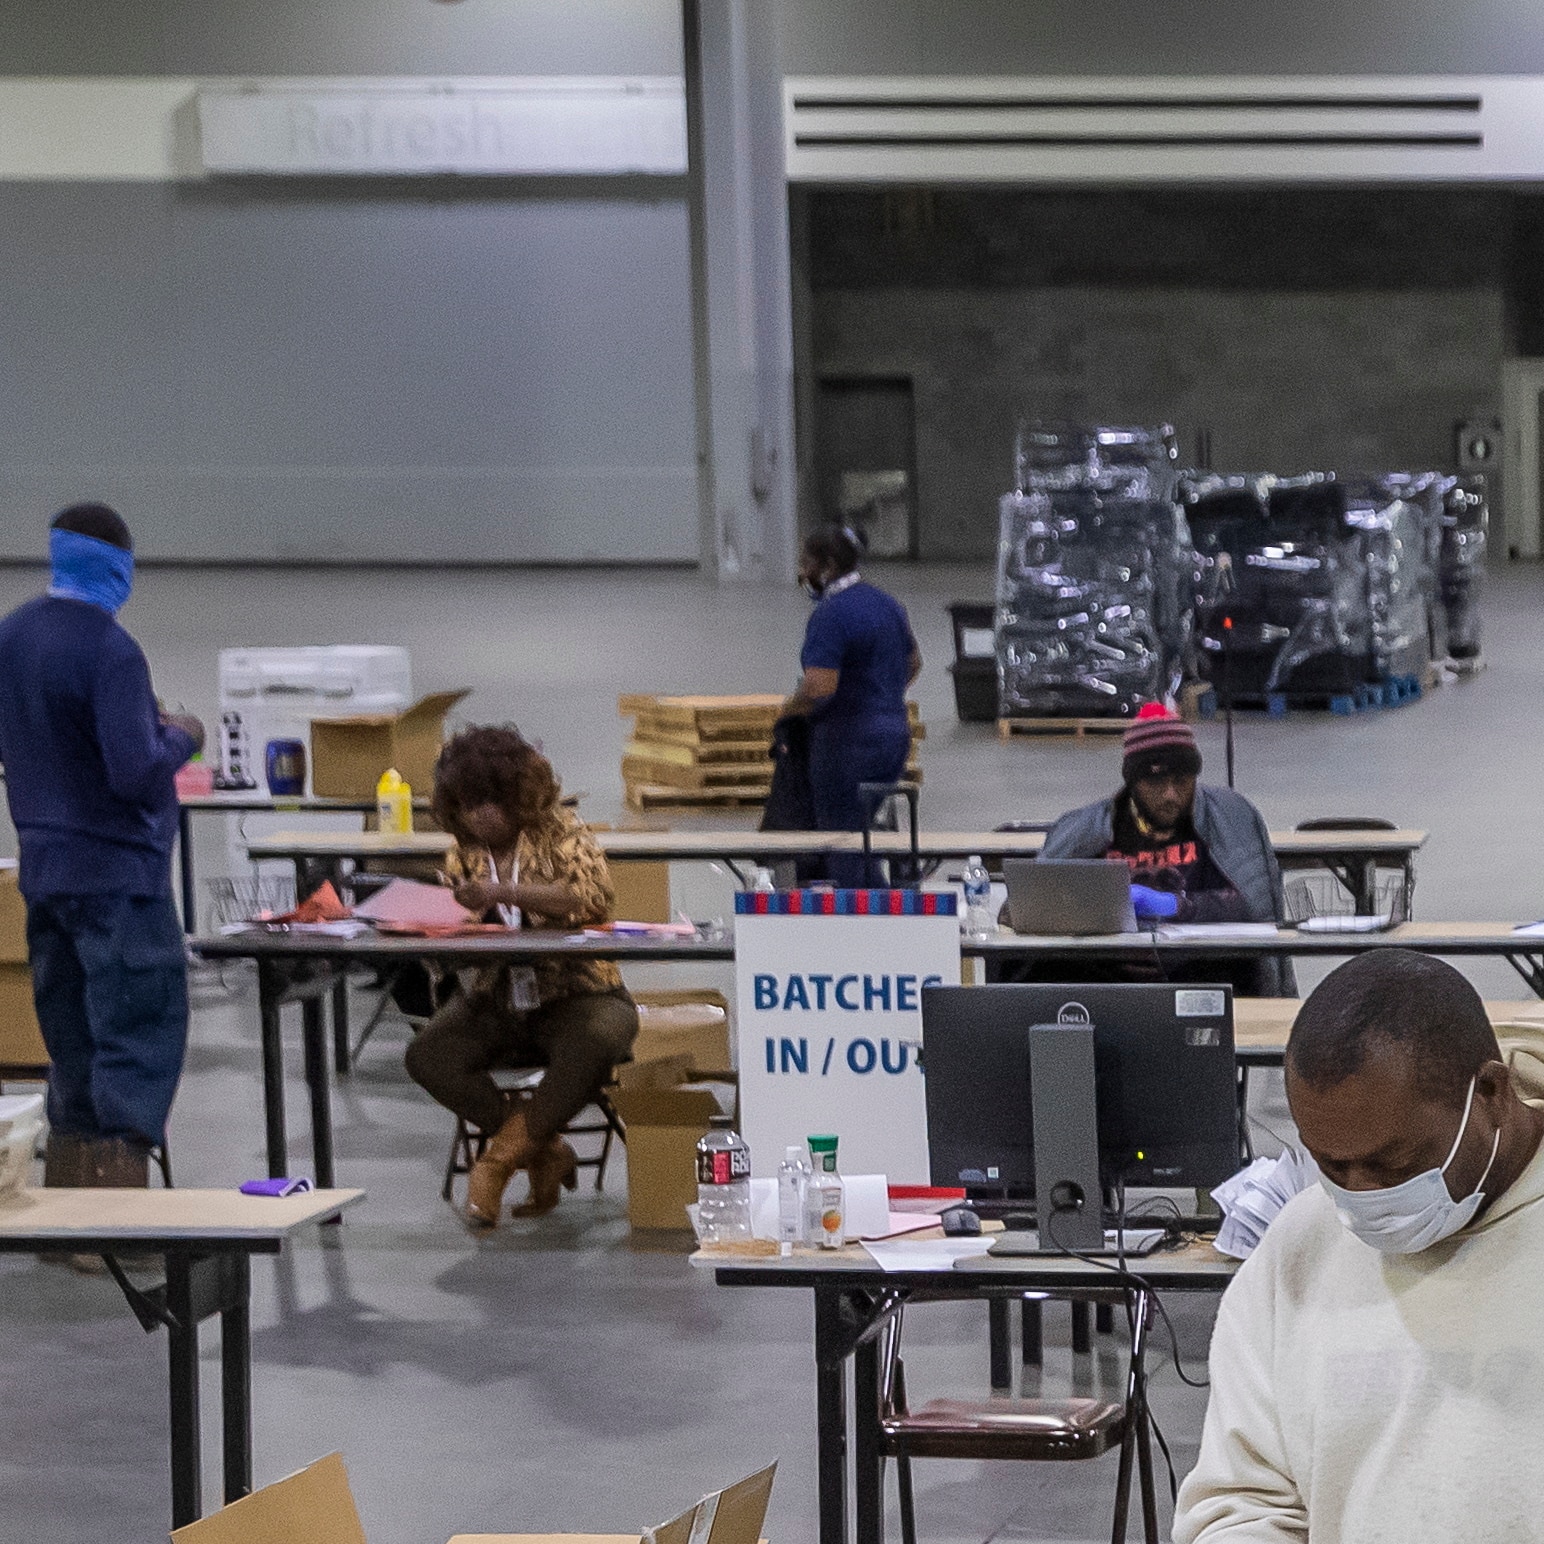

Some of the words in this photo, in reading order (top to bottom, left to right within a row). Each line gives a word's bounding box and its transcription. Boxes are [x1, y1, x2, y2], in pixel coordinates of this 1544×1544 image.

[766, 1038, 808, 1074] IN
[821, 1037, 834, 1075] /
[847, 1037, 925, 1075] OU
